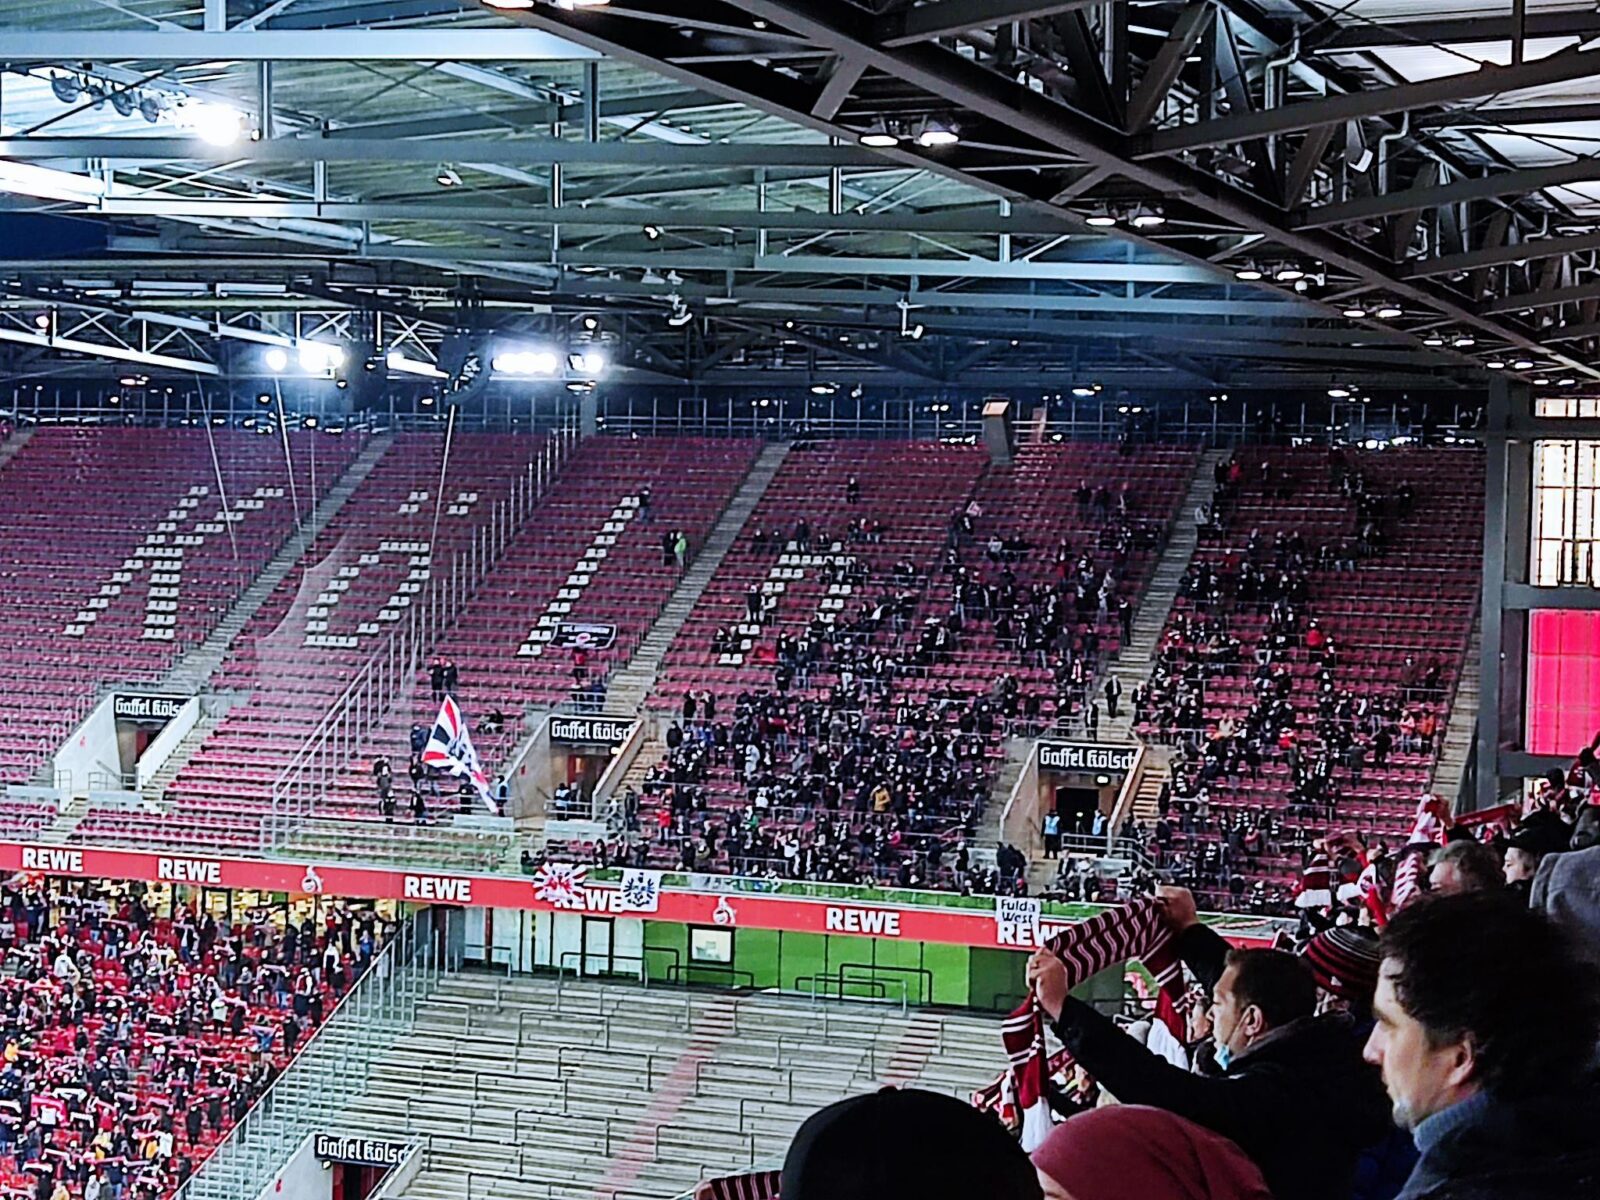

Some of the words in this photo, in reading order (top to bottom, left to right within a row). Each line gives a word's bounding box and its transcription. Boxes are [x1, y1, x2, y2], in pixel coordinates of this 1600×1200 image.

[115, 698, 151, 715] Gaffel
[152, 700, 183, 717] Köls
[552, 721, 590, 739] Gaffel
[1040, 747, 1085, 767] Gaffel
[22, 848, 83, 872] REWE
[157, 858, 221, 883] REWE
[404, 876, 472, 902] REWE
[1001, 899, 1036, 912] Fulda
[826, 907, 901, 935] REWE
[1002, 912, 1033, 924] West
[997, 922, 1075, 948] REW
[318, 1135, 362, 1160] Gaffel
